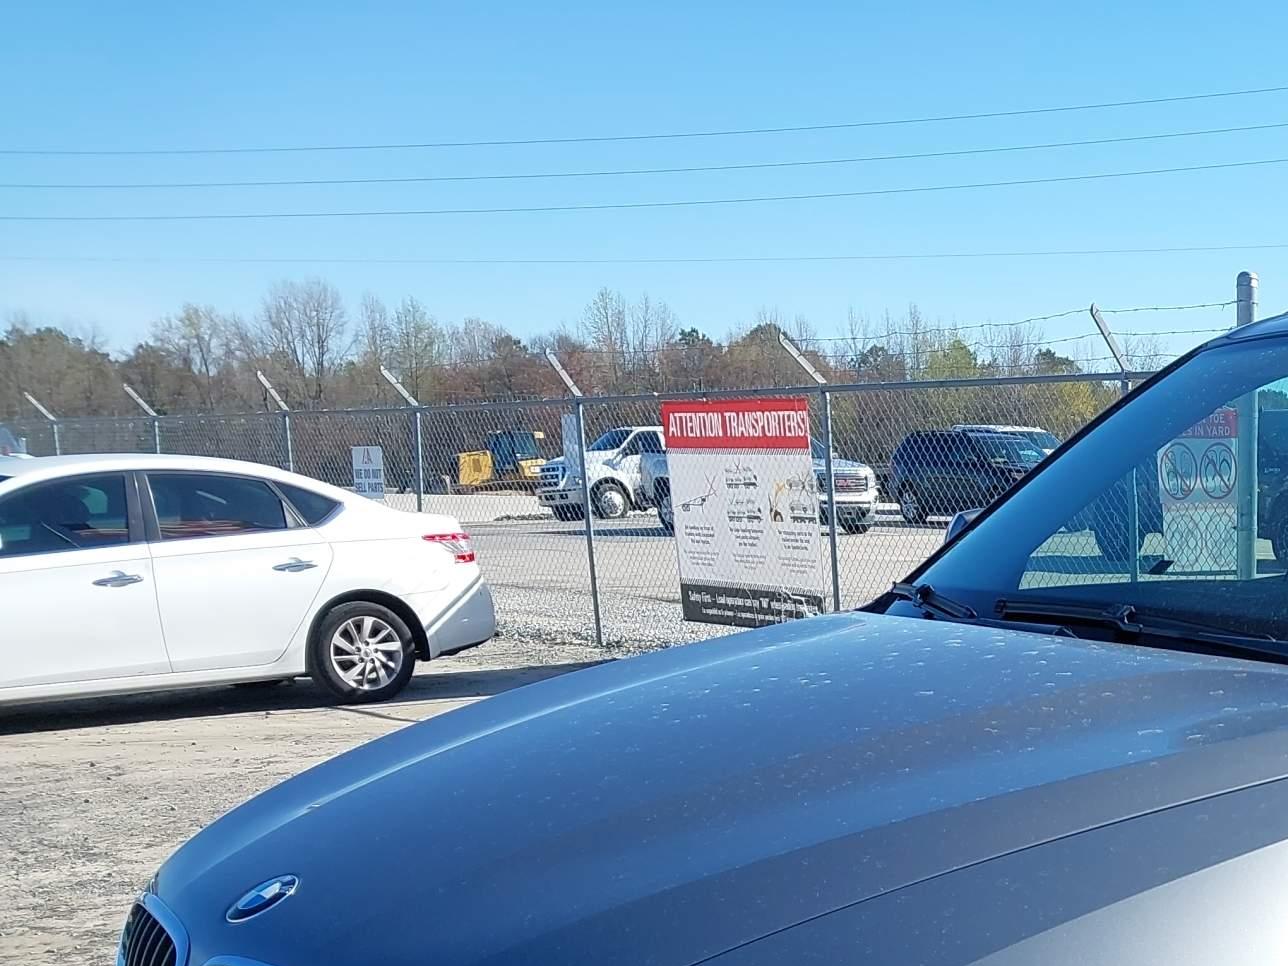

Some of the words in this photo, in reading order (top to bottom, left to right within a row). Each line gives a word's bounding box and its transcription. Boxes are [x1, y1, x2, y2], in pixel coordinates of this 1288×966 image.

[668, 412, 722, 437] ATTENTION
[723, 410, 809, 437] TRANSPORTERS!
[1206, 424, 1231, 437] YARD
[355, 482, 367, 492] SELL
[367, 482, 384, 493] PARTS
